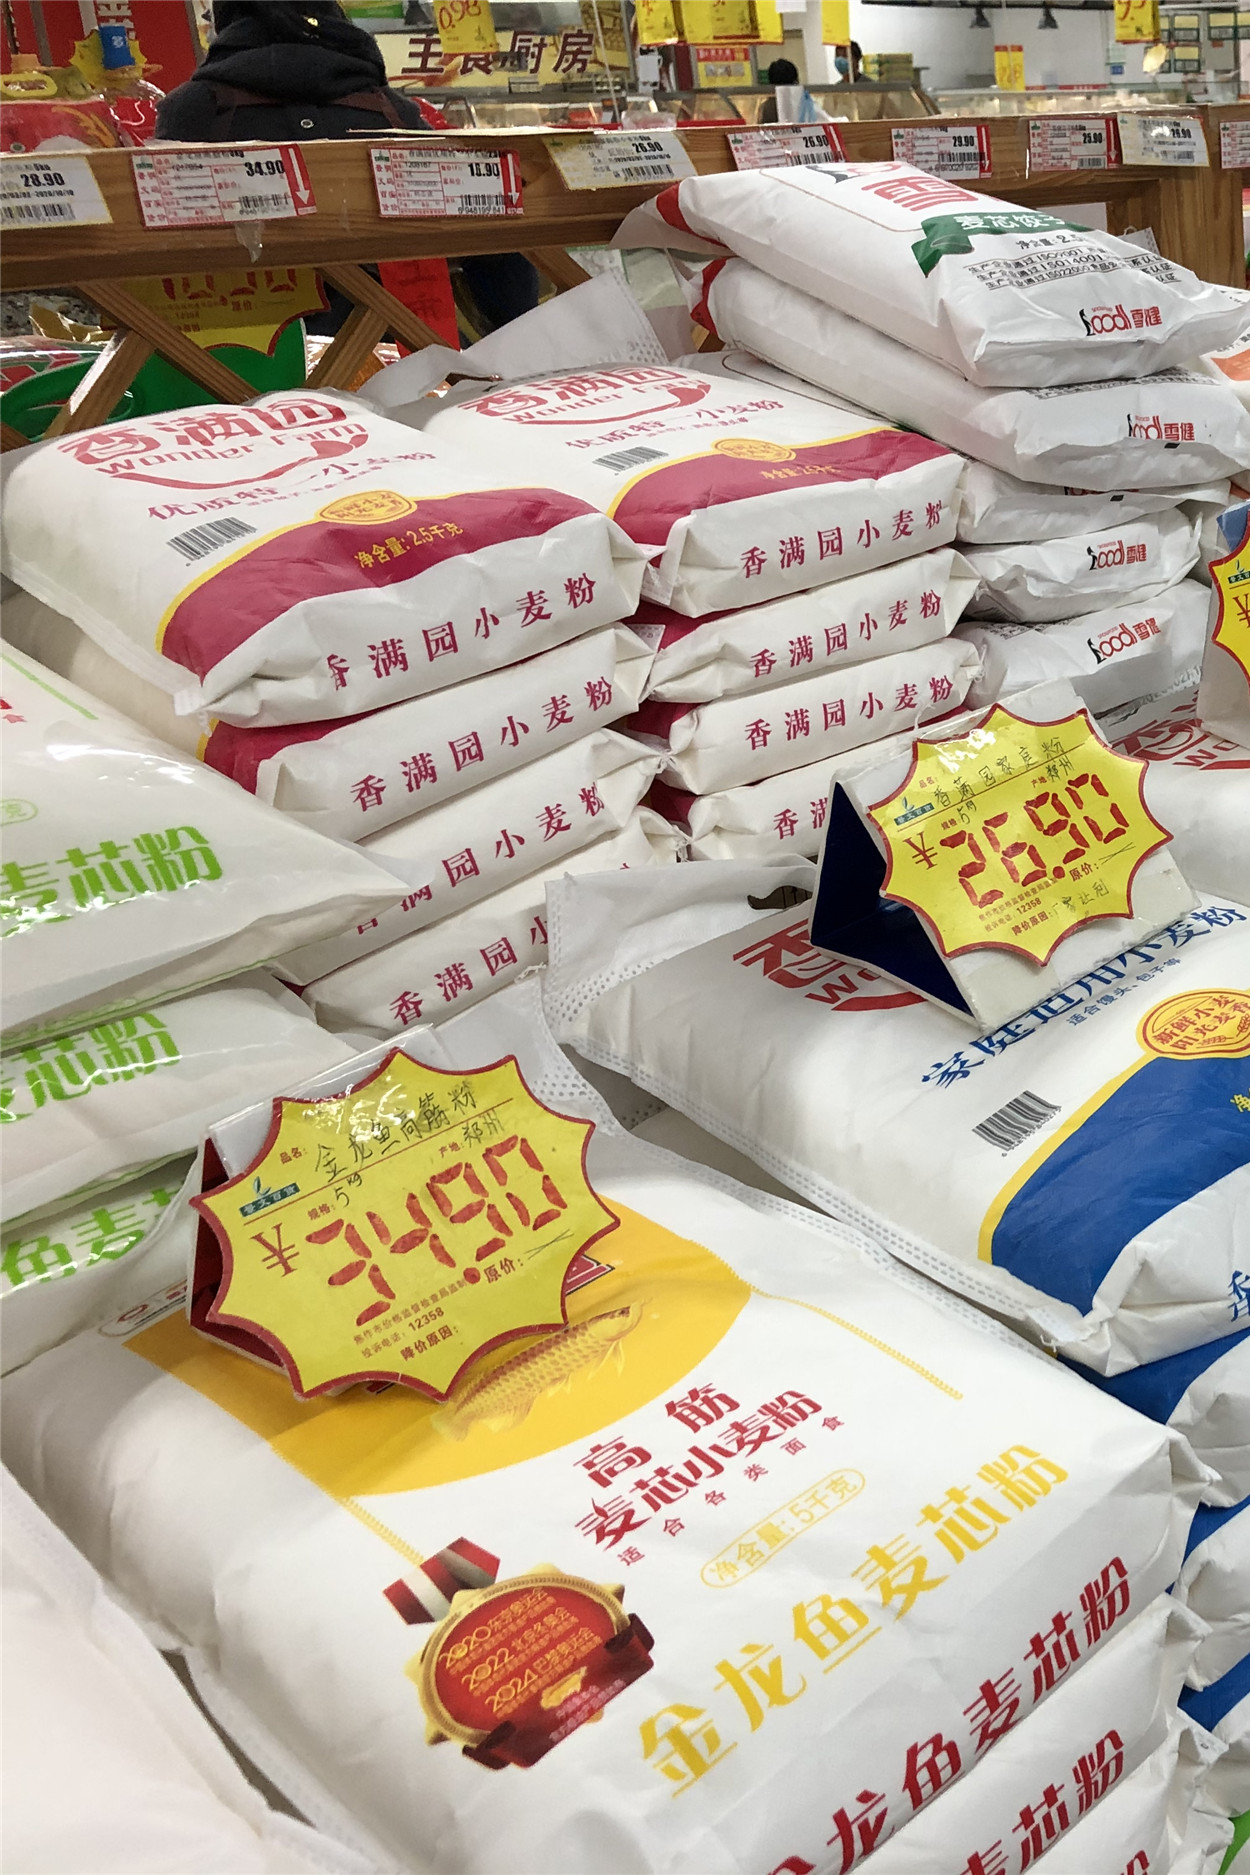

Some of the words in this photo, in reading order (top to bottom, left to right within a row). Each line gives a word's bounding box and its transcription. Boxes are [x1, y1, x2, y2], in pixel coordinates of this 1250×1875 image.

[631, 141, 663, 153] 26.90
[803, 135, 829, 148] 26.90
[20, 172, 65, 188] 28.90
[244, 159, 285, 177] 34.90
[1130, 306, 1163, 328] 雪健
[458, 366, 688, 418] 香满园
[503, 393, 624, 423] Wonder
[57, 397, 348, 466] 香满园
[95, 444, 255, 476] Wonder
[270, 423, 368, 446] Farm
[147, 451, 438, 522] 优质特一小麦粉
[353, 520, 464, 569] 净含量:2.5千克
[740, 500, 944, 579] 香满园小麦粉
[327, 571, 598, 690] 香满园小麦粉
[750, 589, 942, 679] 香满园小麦粉
[744, 675, 954, 750] 香满园小麦粉
[350, 675, 614, 813] 香满园小麦粉
[939, 773, 1130, 909] 26.90
[1069, 861, 1100, 883] 原价:
[1011, 910, 1053, 937] 降价原因:
[1016, 897, 1042, 915] 12358
[1066, 957, 1184, 1027] 适合馒头、包子等
[1152, 994, 1236, 1046] 新鲜小麦
[279, 1145, 309, 1166] 品名:
[438, 1138, 465, 1159] 产地:
[305, 1134, 568, 1327] 34.90
[307, 1201, 336, 1222] 规格:
[484, 1256, 525, 1284] 原价:
[400, 1324, 460, 1362] 降价原因:
[408, 1306, 445, 1332] 12358
[574, 1389, 824, 1552] 麦芯小麦粉
[616, 1413, 847, 1569] 适合各类面食
[707, 1472, 861, 1585] 净含量:5千克
[638, 1443, 1070, 1798] 金龙鱼麦芯粉
[461, 1647, 515, 1692] 2022
